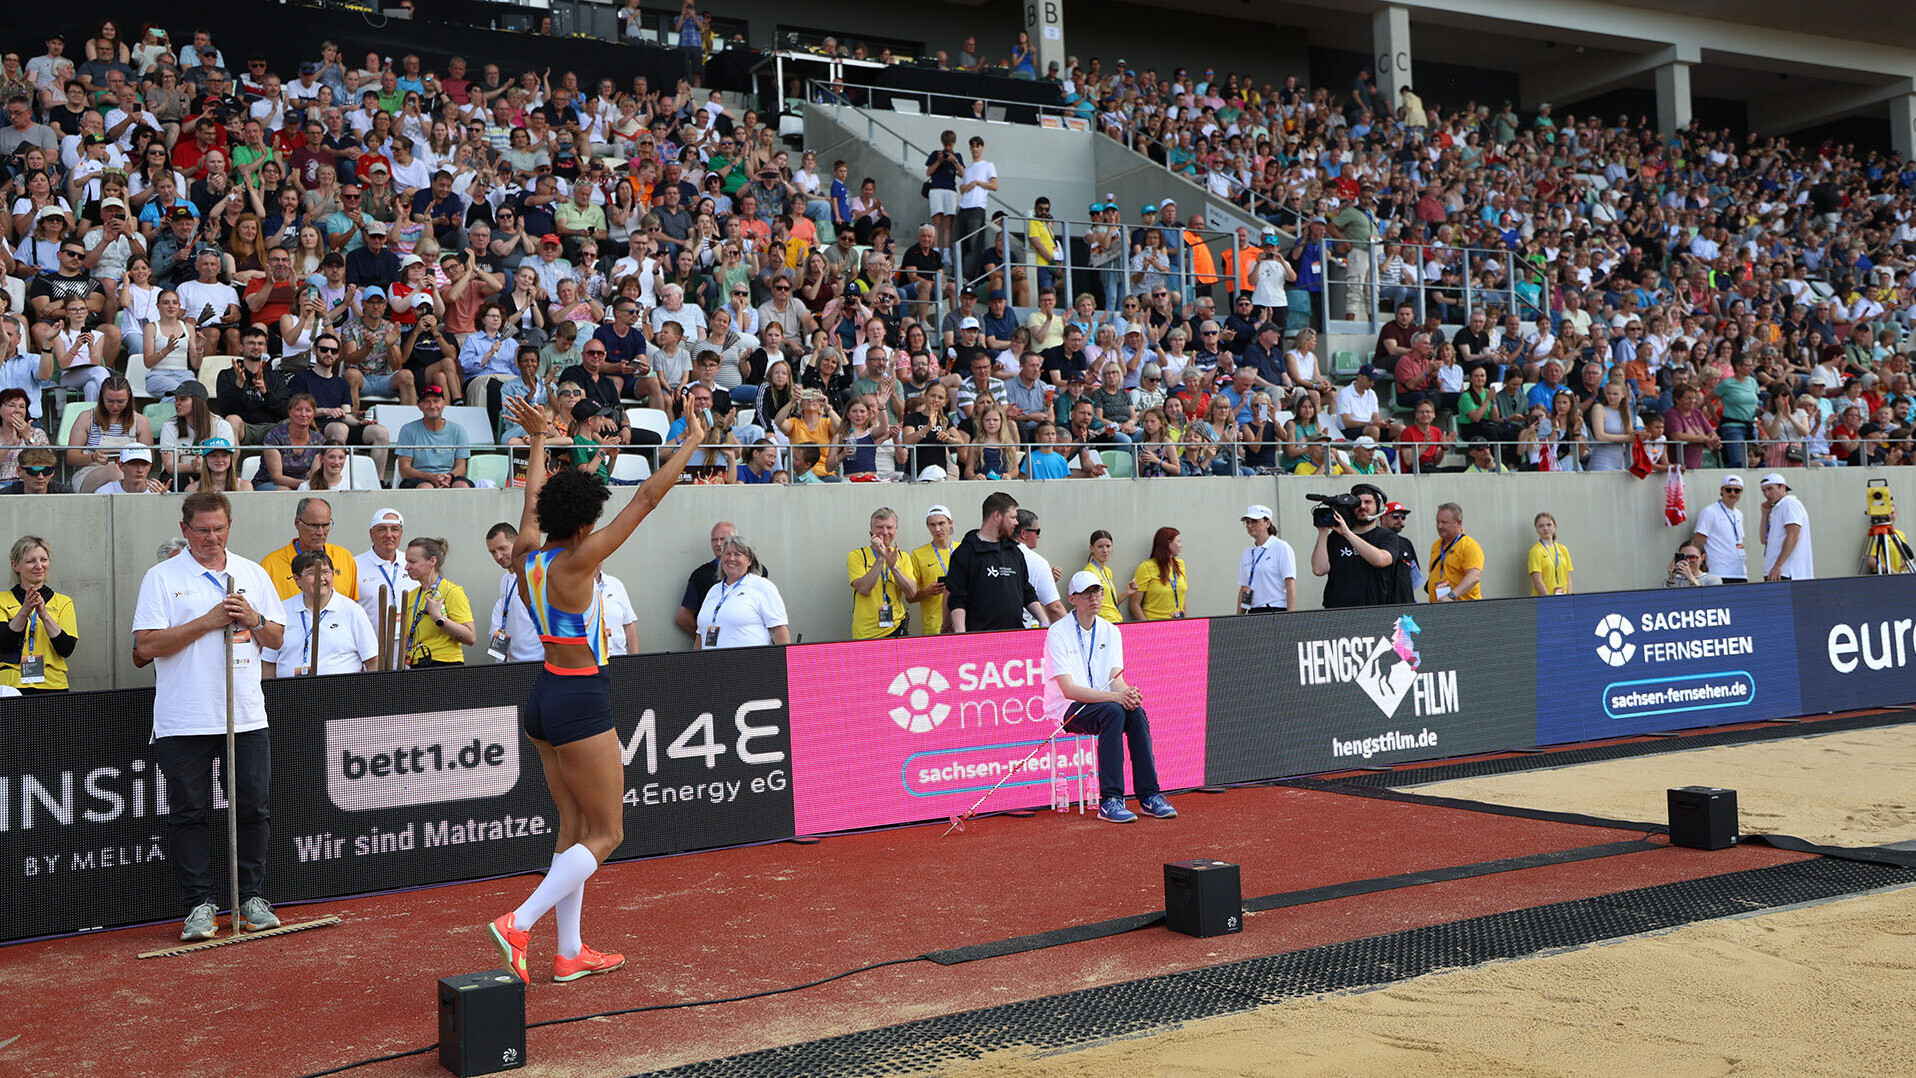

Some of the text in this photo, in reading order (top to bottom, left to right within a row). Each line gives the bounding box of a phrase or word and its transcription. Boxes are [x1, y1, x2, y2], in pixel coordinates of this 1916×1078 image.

[1028, 5, 1036, 27] B
[1045, 2, 1058, 24] B
[1378, 53, 1389, 74] C
[1396, 51, 1408, 72] C
[1641, 608, 1731, 632] SACHSEN
[1643, 636, 1753, 663] FERNSEHEN
[1828, 618, 1916, 674] eur
[958, 658, 1045, 691] SACH
[1298, 636, 1375, 686] HENGST
[1412, 670, 1459, 717] FILM
[1611, 681, 1747, 709] sachsen-fernsehen.de
[1332, 728, 1438, 759] hengstfilm.de
[342, 738, 505, 780] bett1.de
[918, 749, 1095, 783] sachsen-meda.de
[750, 769, 787, 793] eG
[294, 814, 552, 863] Wir sind Matratze.
[25, 854, 60, 876] BY
